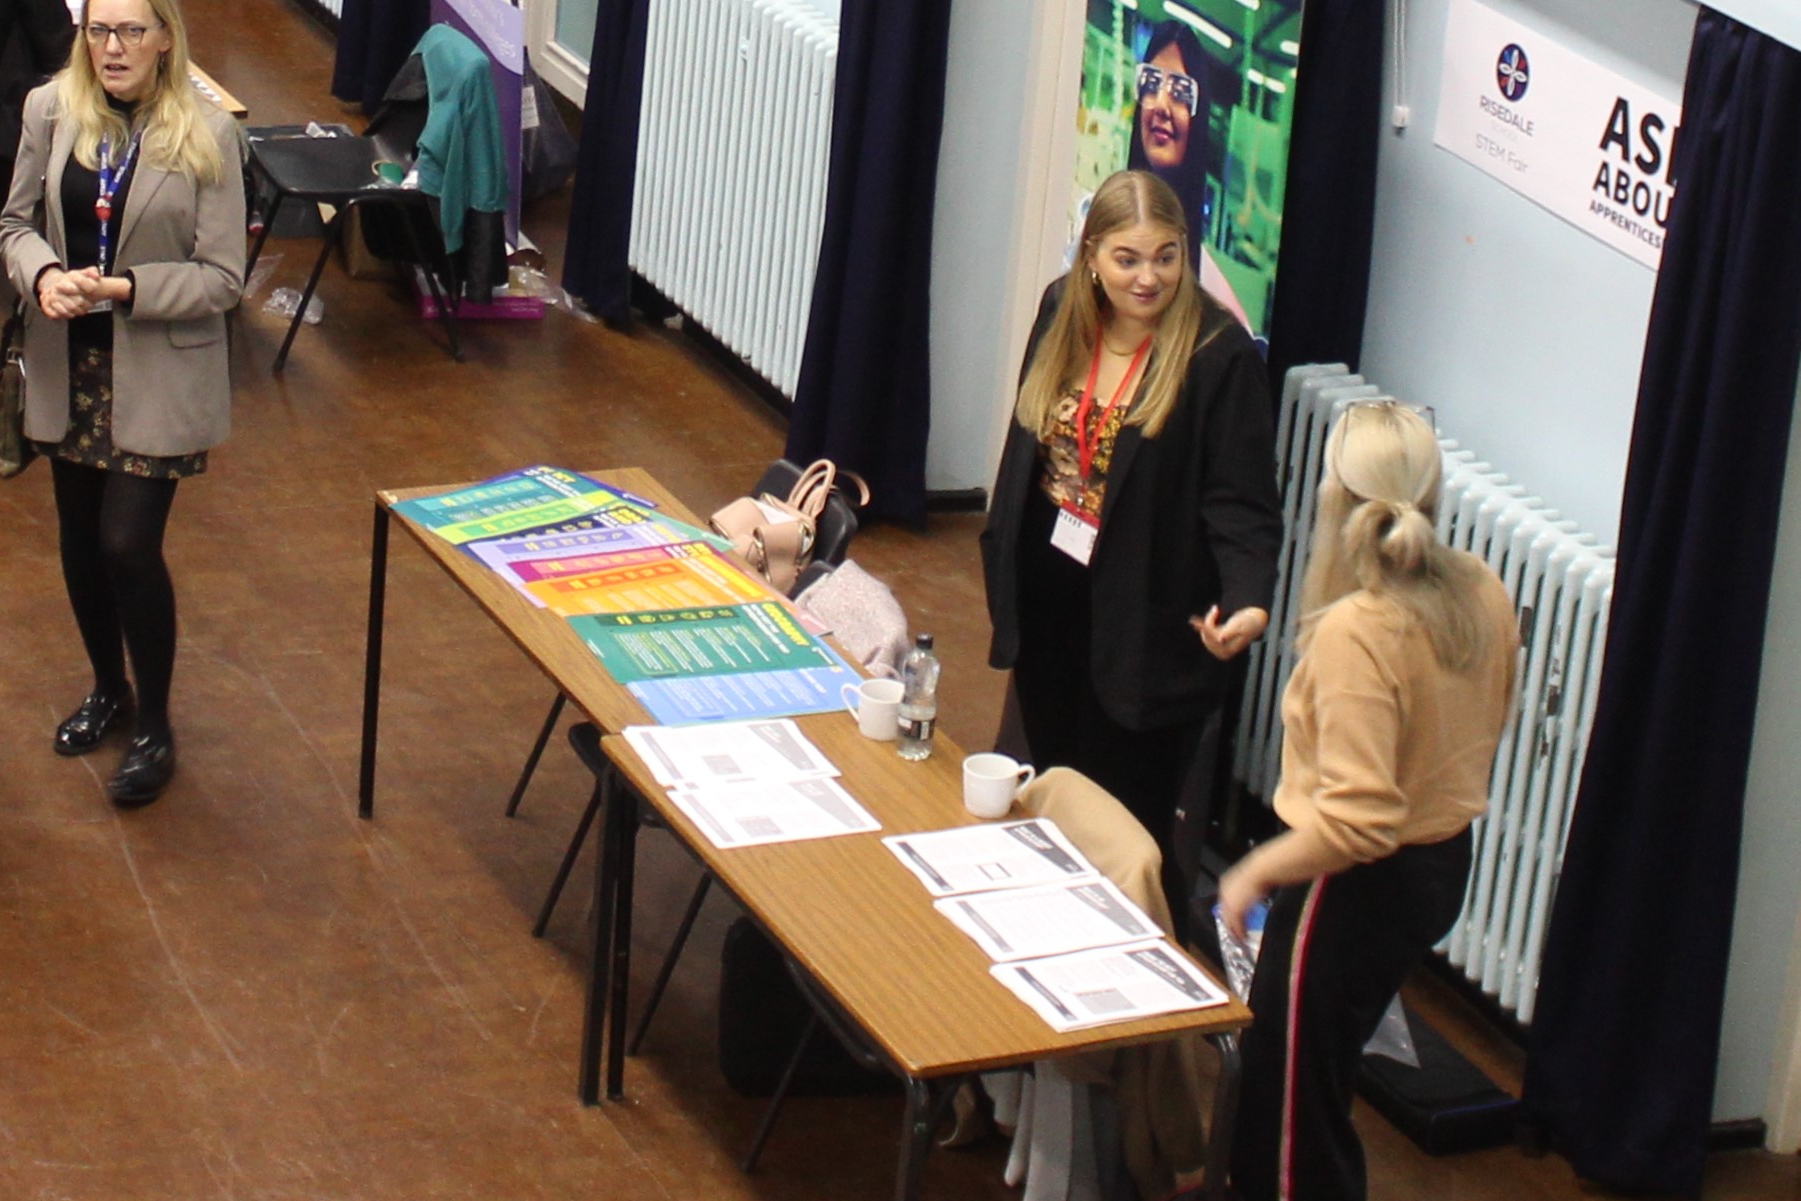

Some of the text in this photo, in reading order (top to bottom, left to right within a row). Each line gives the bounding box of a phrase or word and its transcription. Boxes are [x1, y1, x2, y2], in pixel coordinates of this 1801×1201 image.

[1480, 95, 1534, 137] RISEDALE
[1476, 133, 1506, 161] STEM
[1592, 161, 1670, 229] ABOU
[1589, 201, 1662, 249] APPRENTICES
